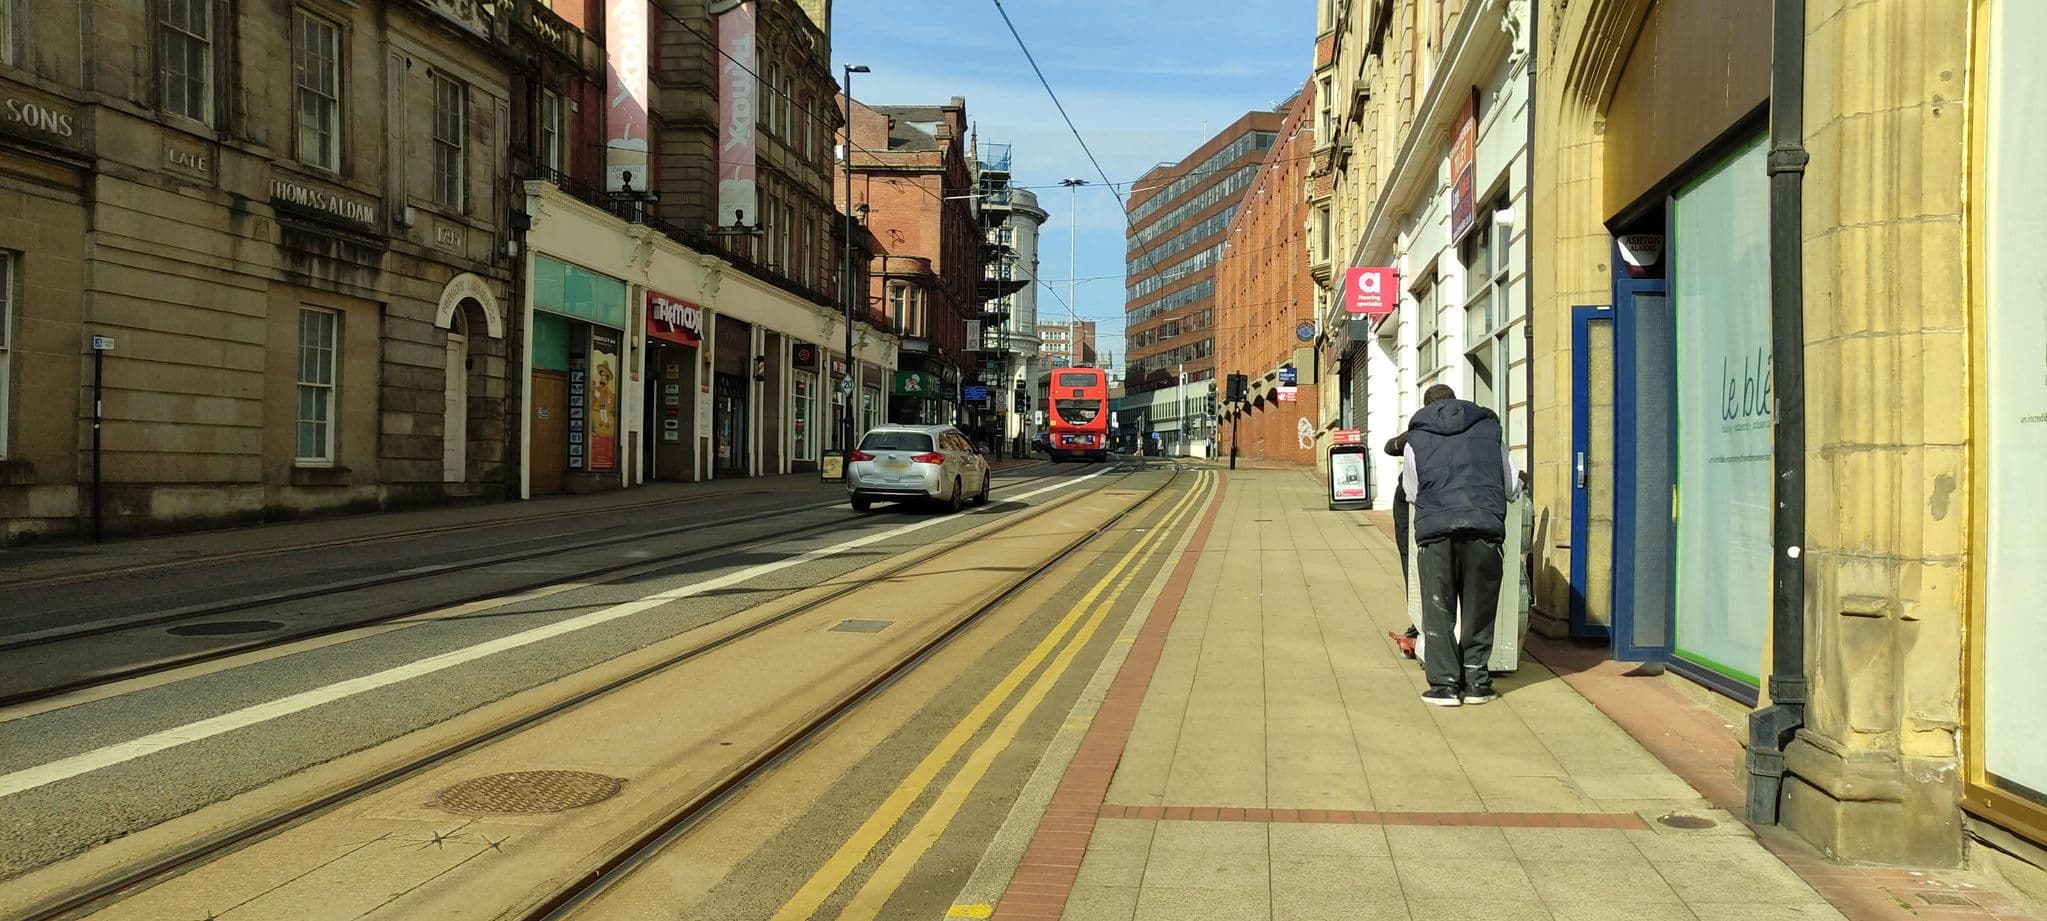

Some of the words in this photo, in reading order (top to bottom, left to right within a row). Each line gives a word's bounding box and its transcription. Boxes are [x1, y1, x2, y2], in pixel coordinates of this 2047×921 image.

[6, 98, 73, 137] SONS
[169, 149, 206, 171] LATE
[270, 178, 326, 211] THOMAS
[329, 196, 374, 224] ALDAM
[1625, 235, 1661, 245] ASHTON
[843, 380, 853, 389] 20
[1721, 355, 1739, 421] le
